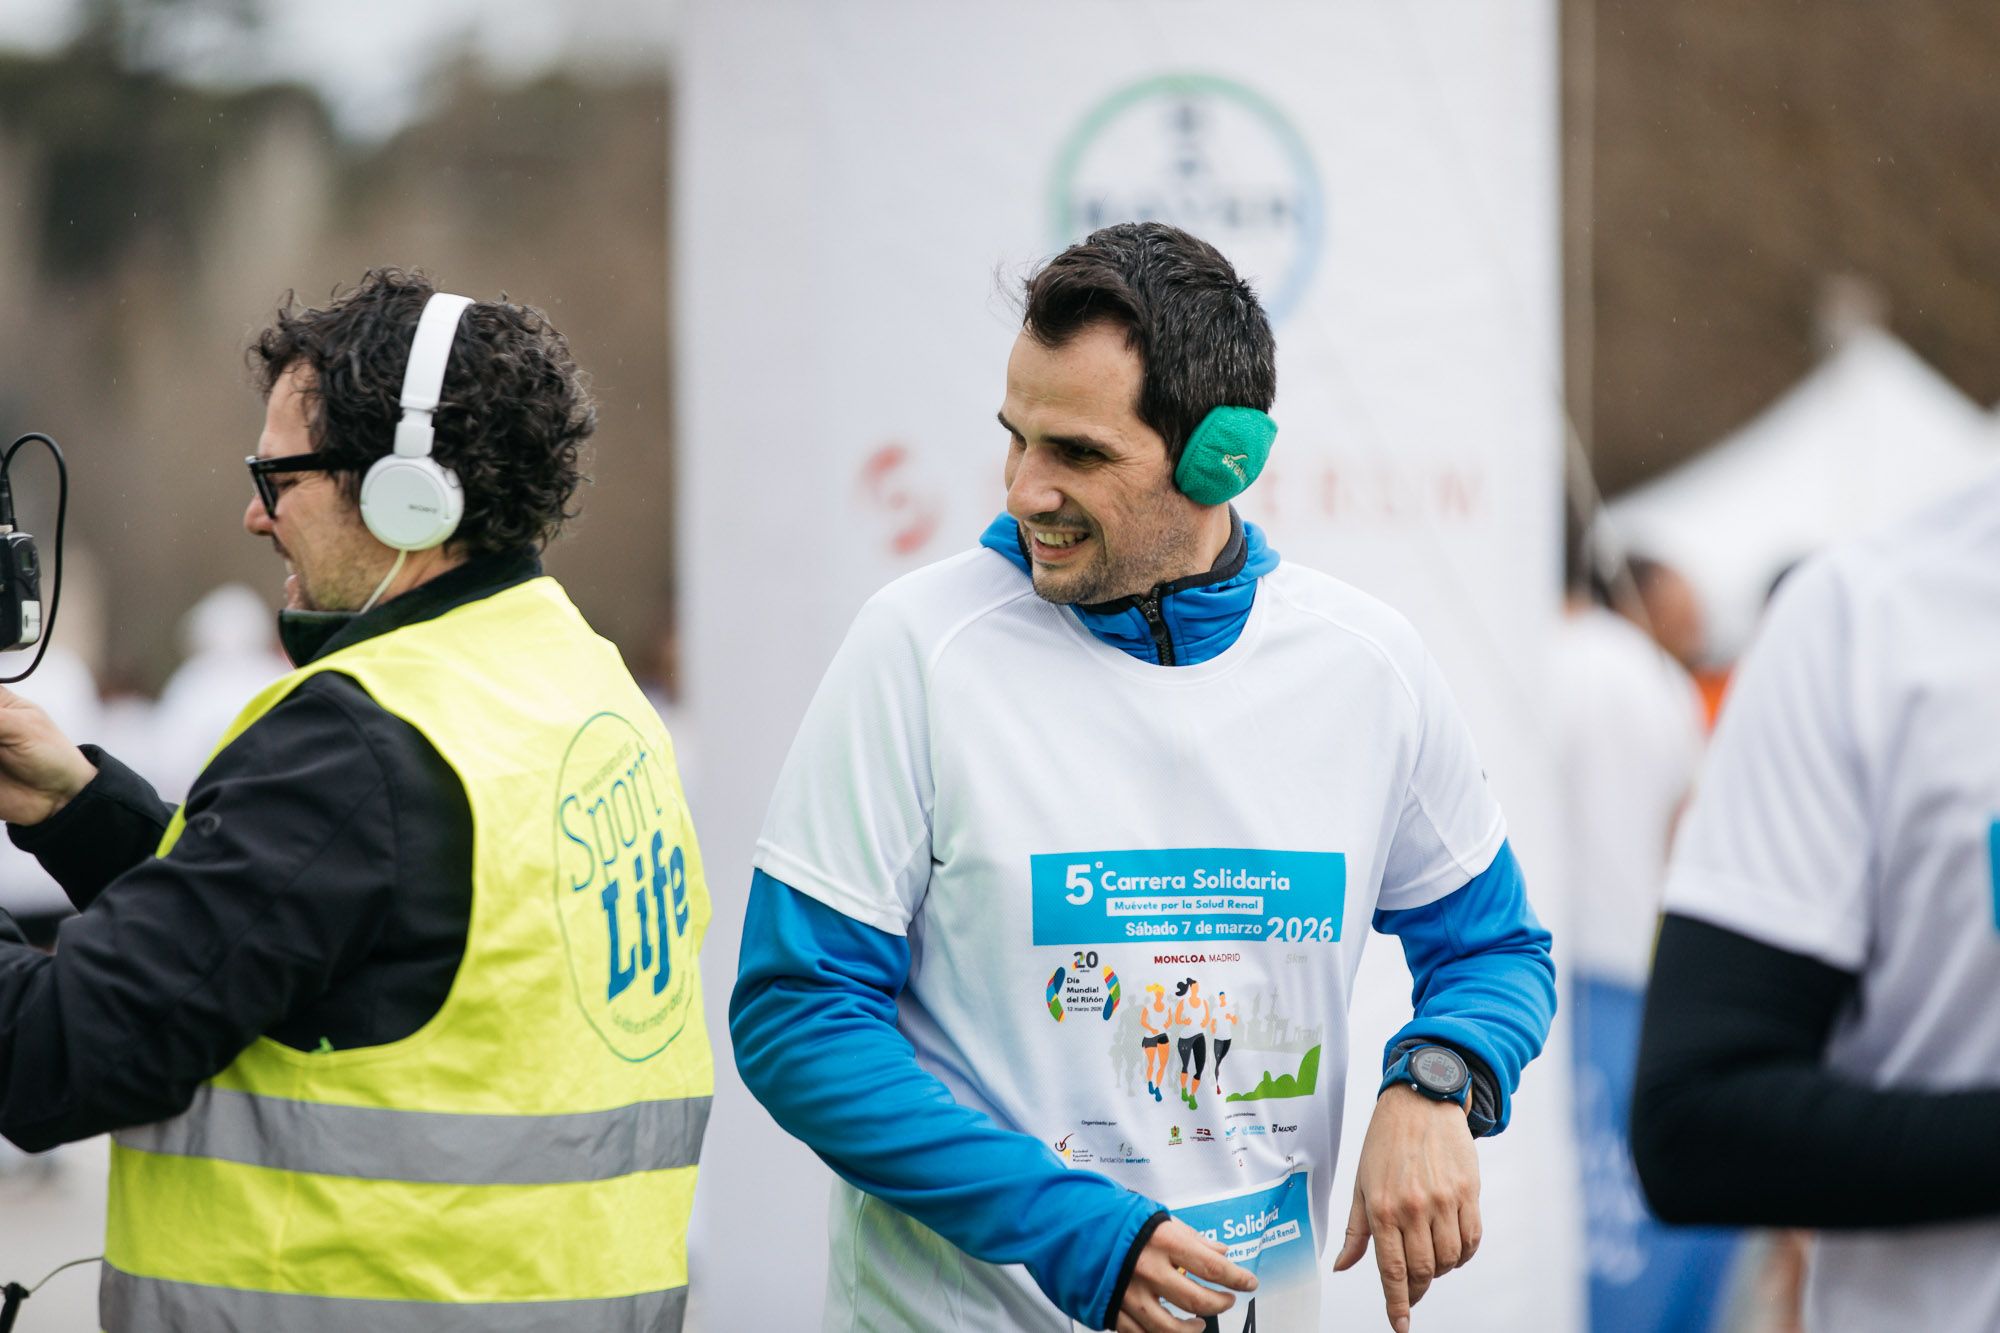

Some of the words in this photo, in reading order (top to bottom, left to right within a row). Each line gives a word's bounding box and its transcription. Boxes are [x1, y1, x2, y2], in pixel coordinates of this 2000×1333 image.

[560, 741, 663, 892] Sport
[1101, 870, 1186, 891] Carrera
[1193, 868, 1290, 891] Solidaria
[601, 829, 689, 1004] Life
[1115, 900, 1158, 911] Muévete
[1161, 902, 1180, 912] por
[1182, 900, 1192, 909] la
[1196, 899, 1224, 909] Salud
[1227, 900, 1259, 909] Renal
[1125, 920, 1179, 937] Sábado
[1182, 921, 1192, 935] 7
[1195, 920, 1213, 935] de
[1216, 923, 1263, 935] marzo
[1266, 916, 1334, 943] 2026
[1072, 951, 1099, 969] 20
[1154, 954, 1206, 965] MONCLOA
[1208, 953, 1241, 963] MADRID
[1246, 1245, 1258, 1256] por
[1277, 1223, 1297, 1240] Renal
